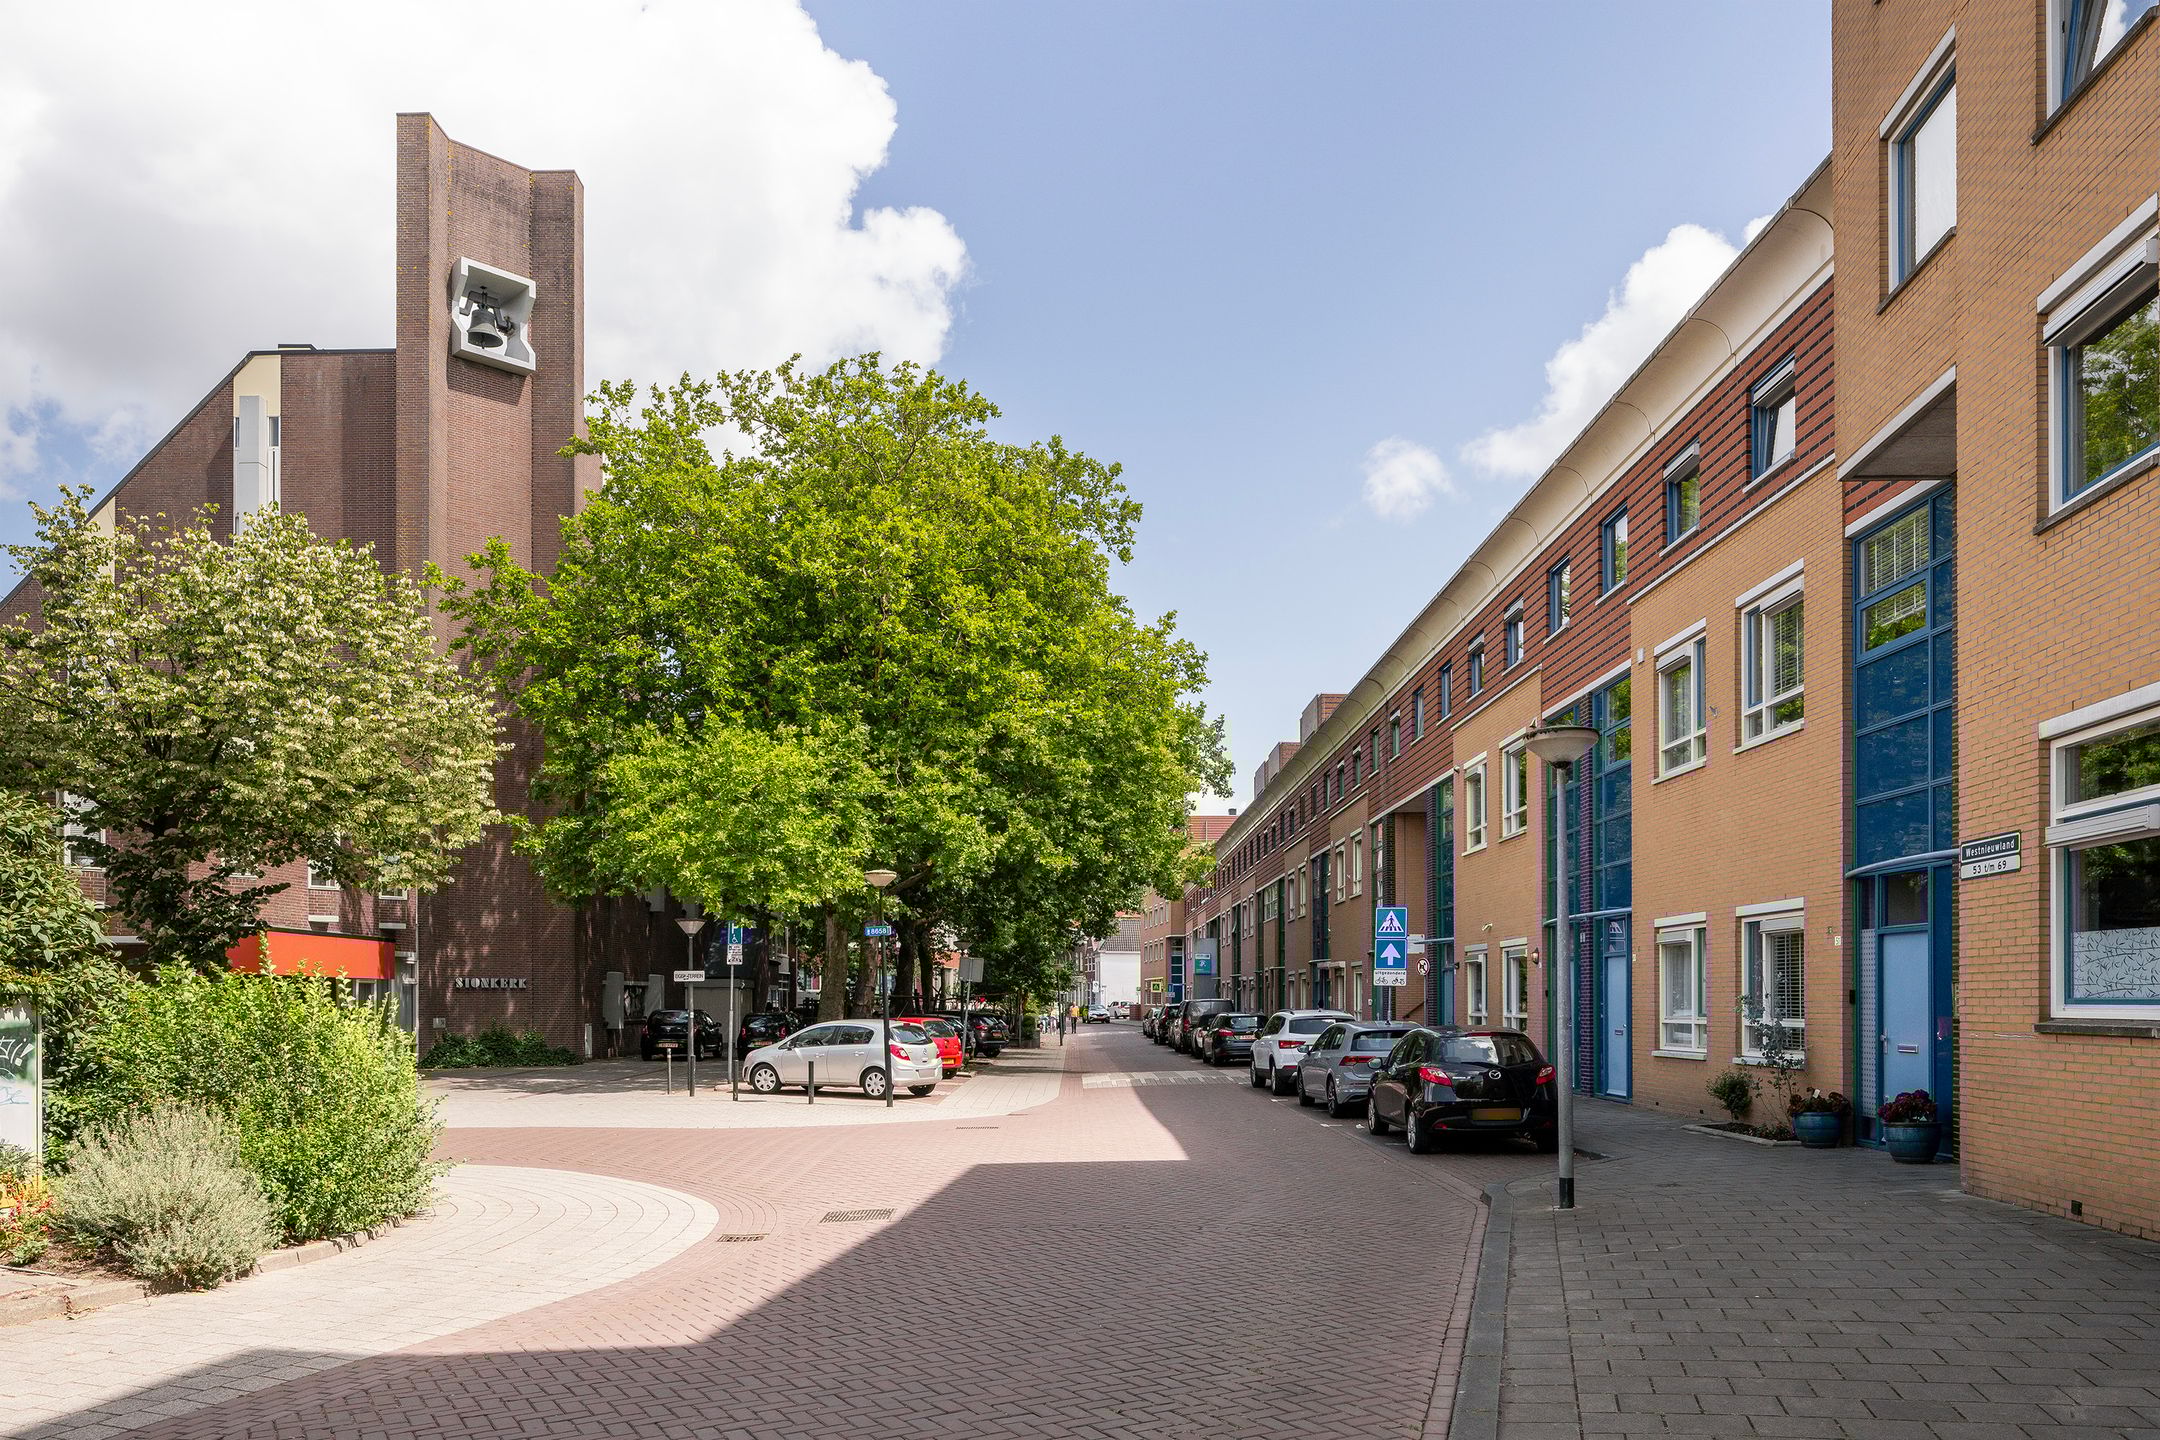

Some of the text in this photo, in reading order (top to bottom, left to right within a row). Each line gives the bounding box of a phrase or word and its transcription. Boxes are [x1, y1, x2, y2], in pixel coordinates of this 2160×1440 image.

[1965, 839, 2015, 857] Westnieuwland
[1972, 860, 2007, 875] 53 t/m 69
[455, 977, 527, 989] SIONKERK
